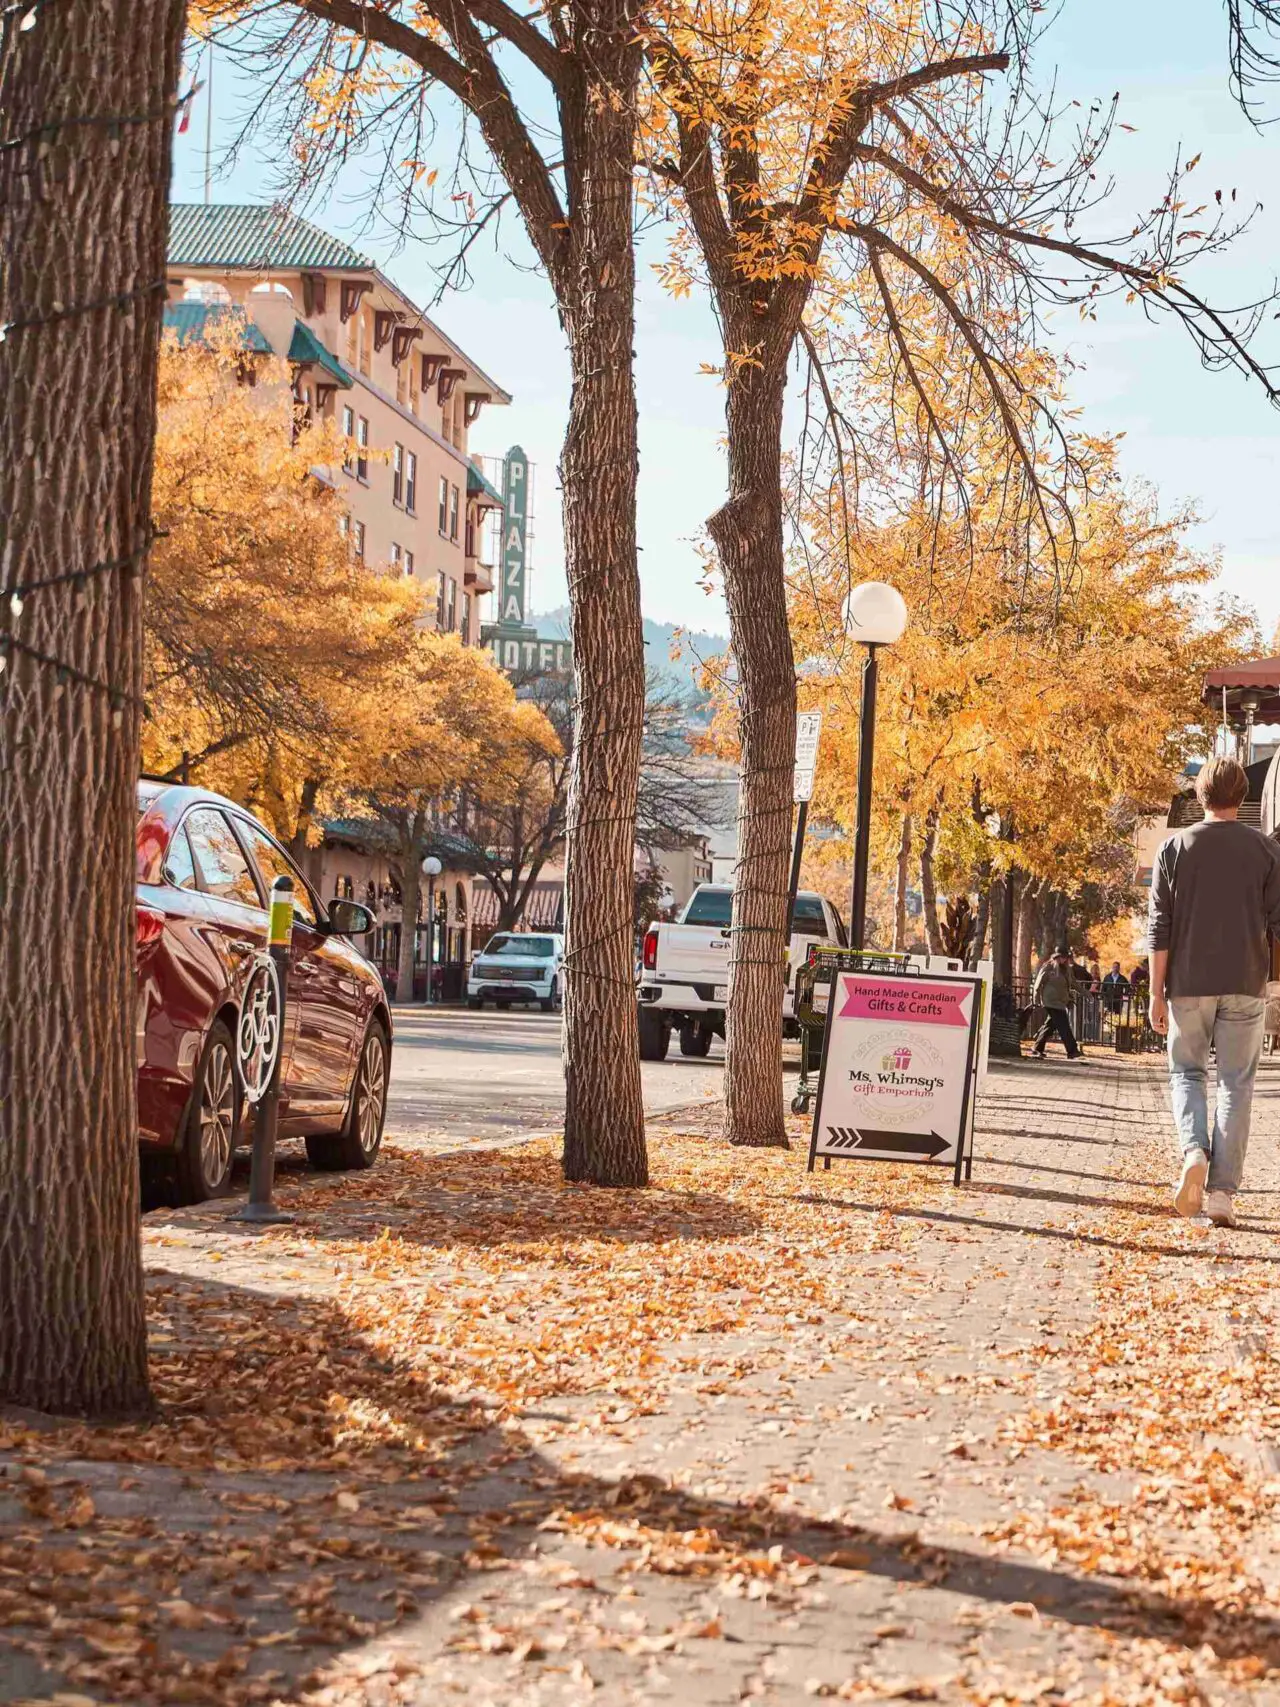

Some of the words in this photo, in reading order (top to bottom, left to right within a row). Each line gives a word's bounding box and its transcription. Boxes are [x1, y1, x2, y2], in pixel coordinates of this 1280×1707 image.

[504, 461, 524, 622] PLAZA
[854, 986, 880, 997] Hand
[882, 988, 909, 999] Made
[912, 990, 957, 1002] Canadian
[868, 999, 894, 1012] Gifts
[897, 1001, 907, 1013] &
[908, 1002, 942, 1015] Crafts
[848, 1070, 872, 1083] Ms.
[877, 1072, 944, 1092] Whimsy's
[853, 1084, 876, 1096] Gift
[877, 1086, 934, 1098] Emporium
